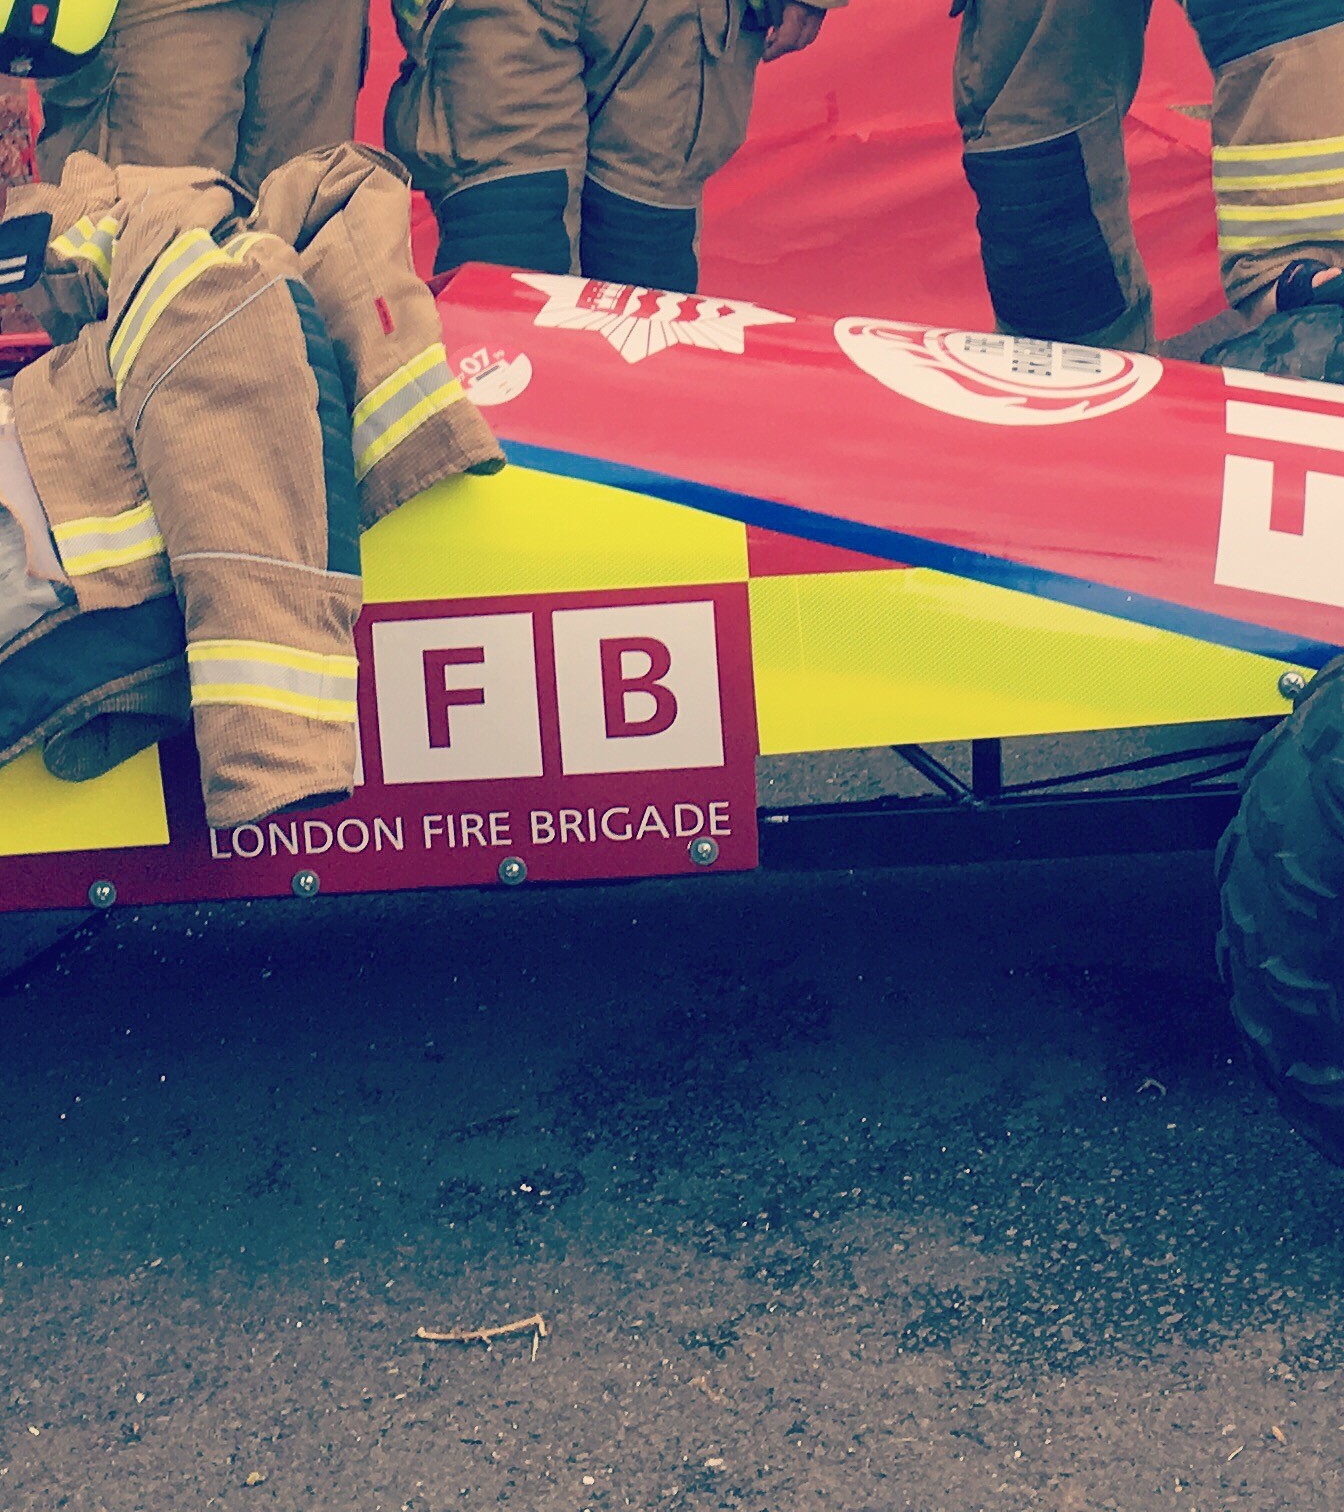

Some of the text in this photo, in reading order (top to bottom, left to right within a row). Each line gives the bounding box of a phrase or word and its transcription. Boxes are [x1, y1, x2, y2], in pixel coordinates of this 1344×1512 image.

[208, 801, 733, 860] LONDON FIRE BRIGADE
